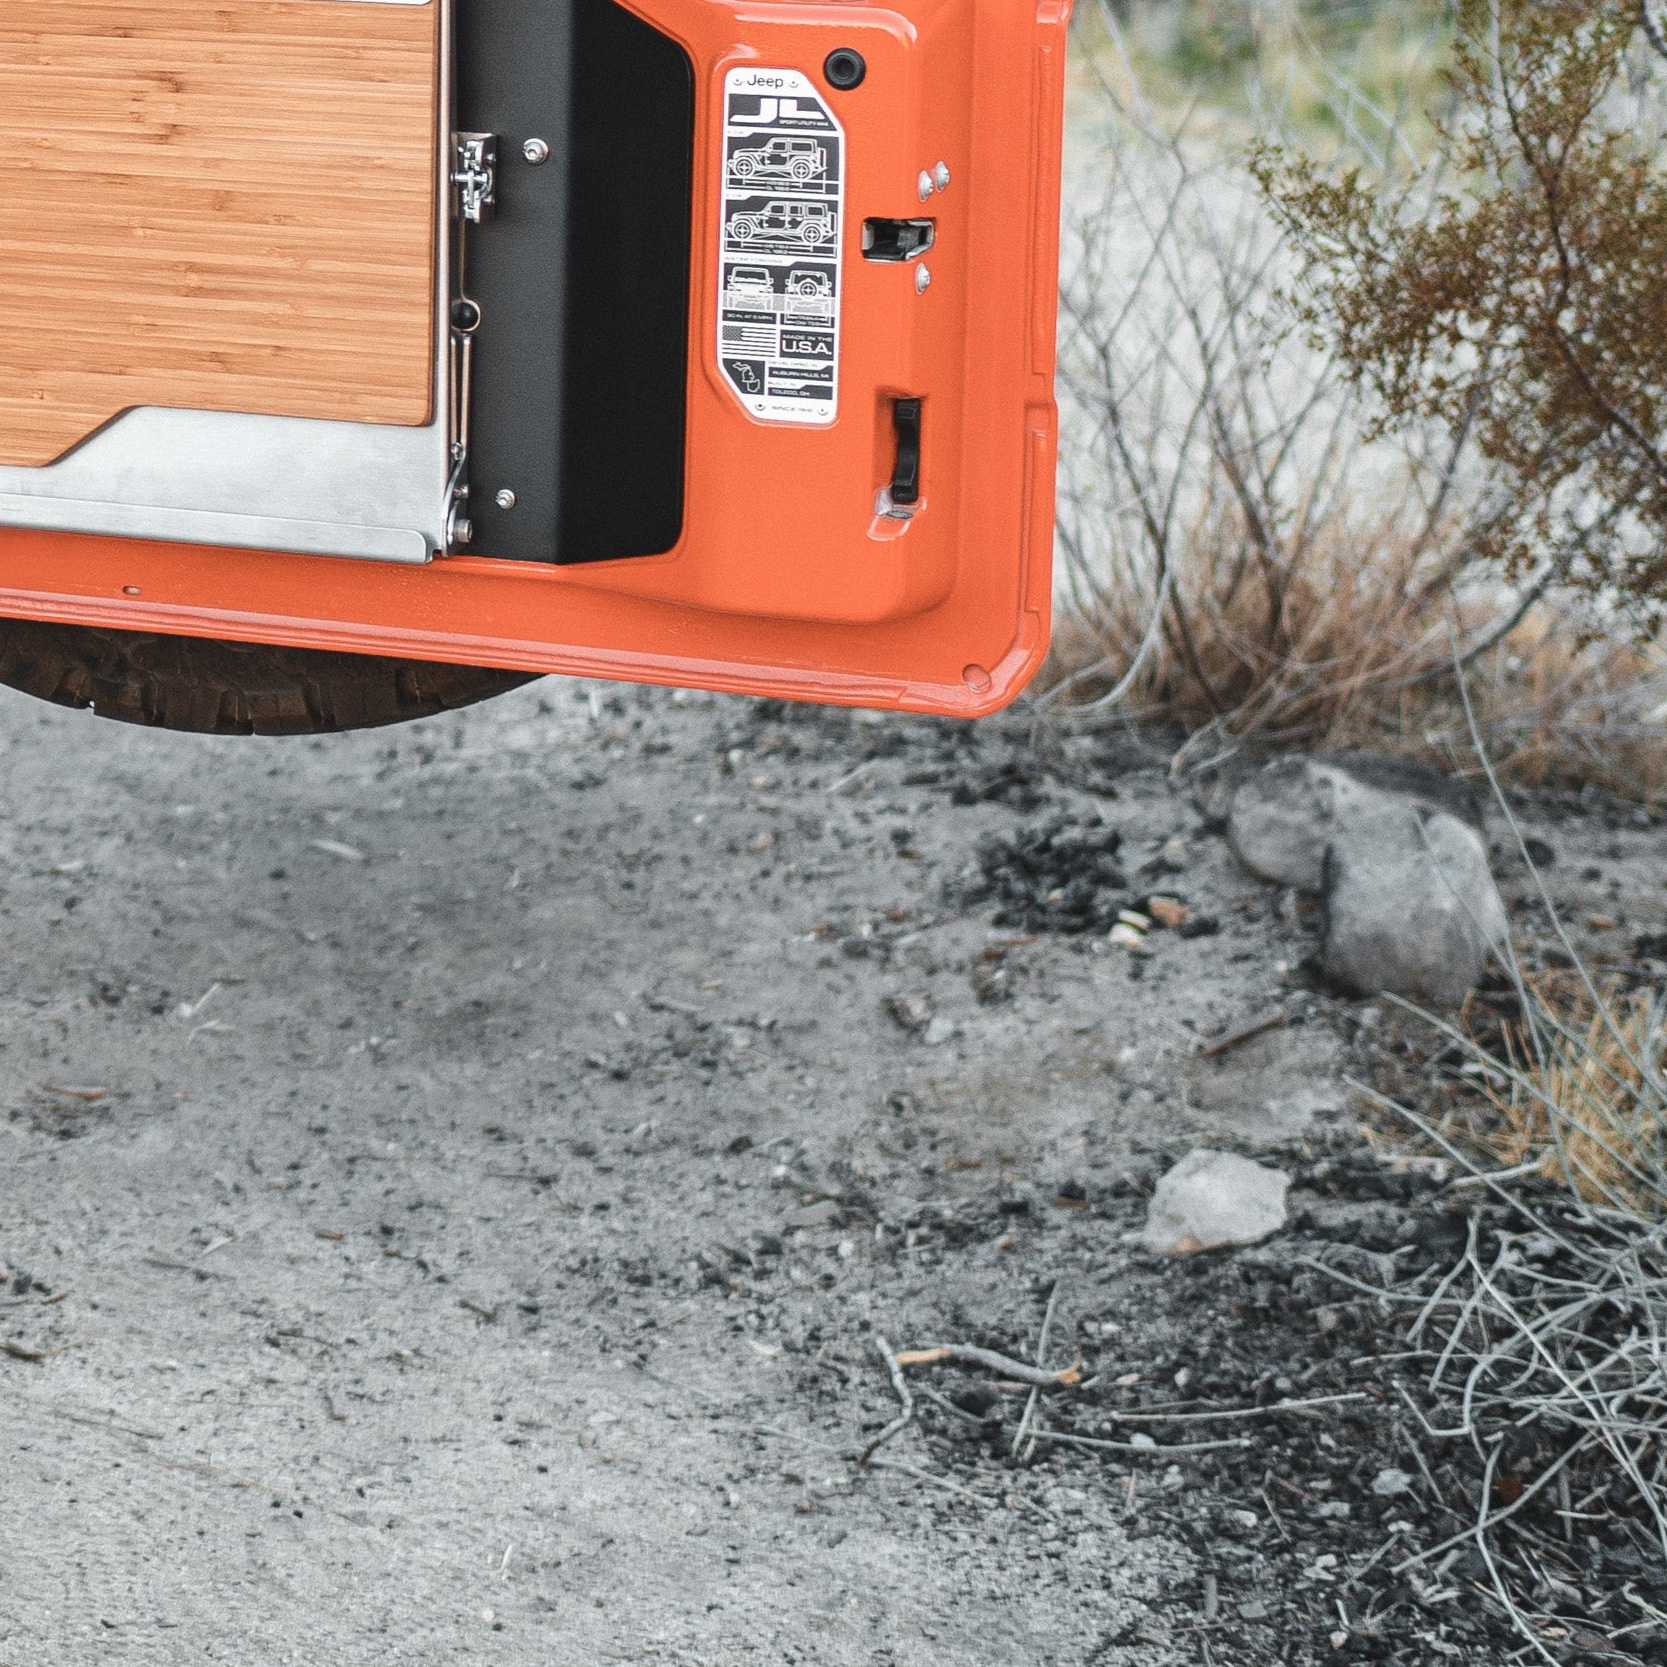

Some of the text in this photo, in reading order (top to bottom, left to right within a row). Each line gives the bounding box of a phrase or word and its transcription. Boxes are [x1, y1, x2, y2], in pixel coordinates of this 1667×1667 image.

[747, 74, 784, 89] Jeep
[729, 97, 826, 124] JL
[782, 339, 833, 355] U.S.A.
